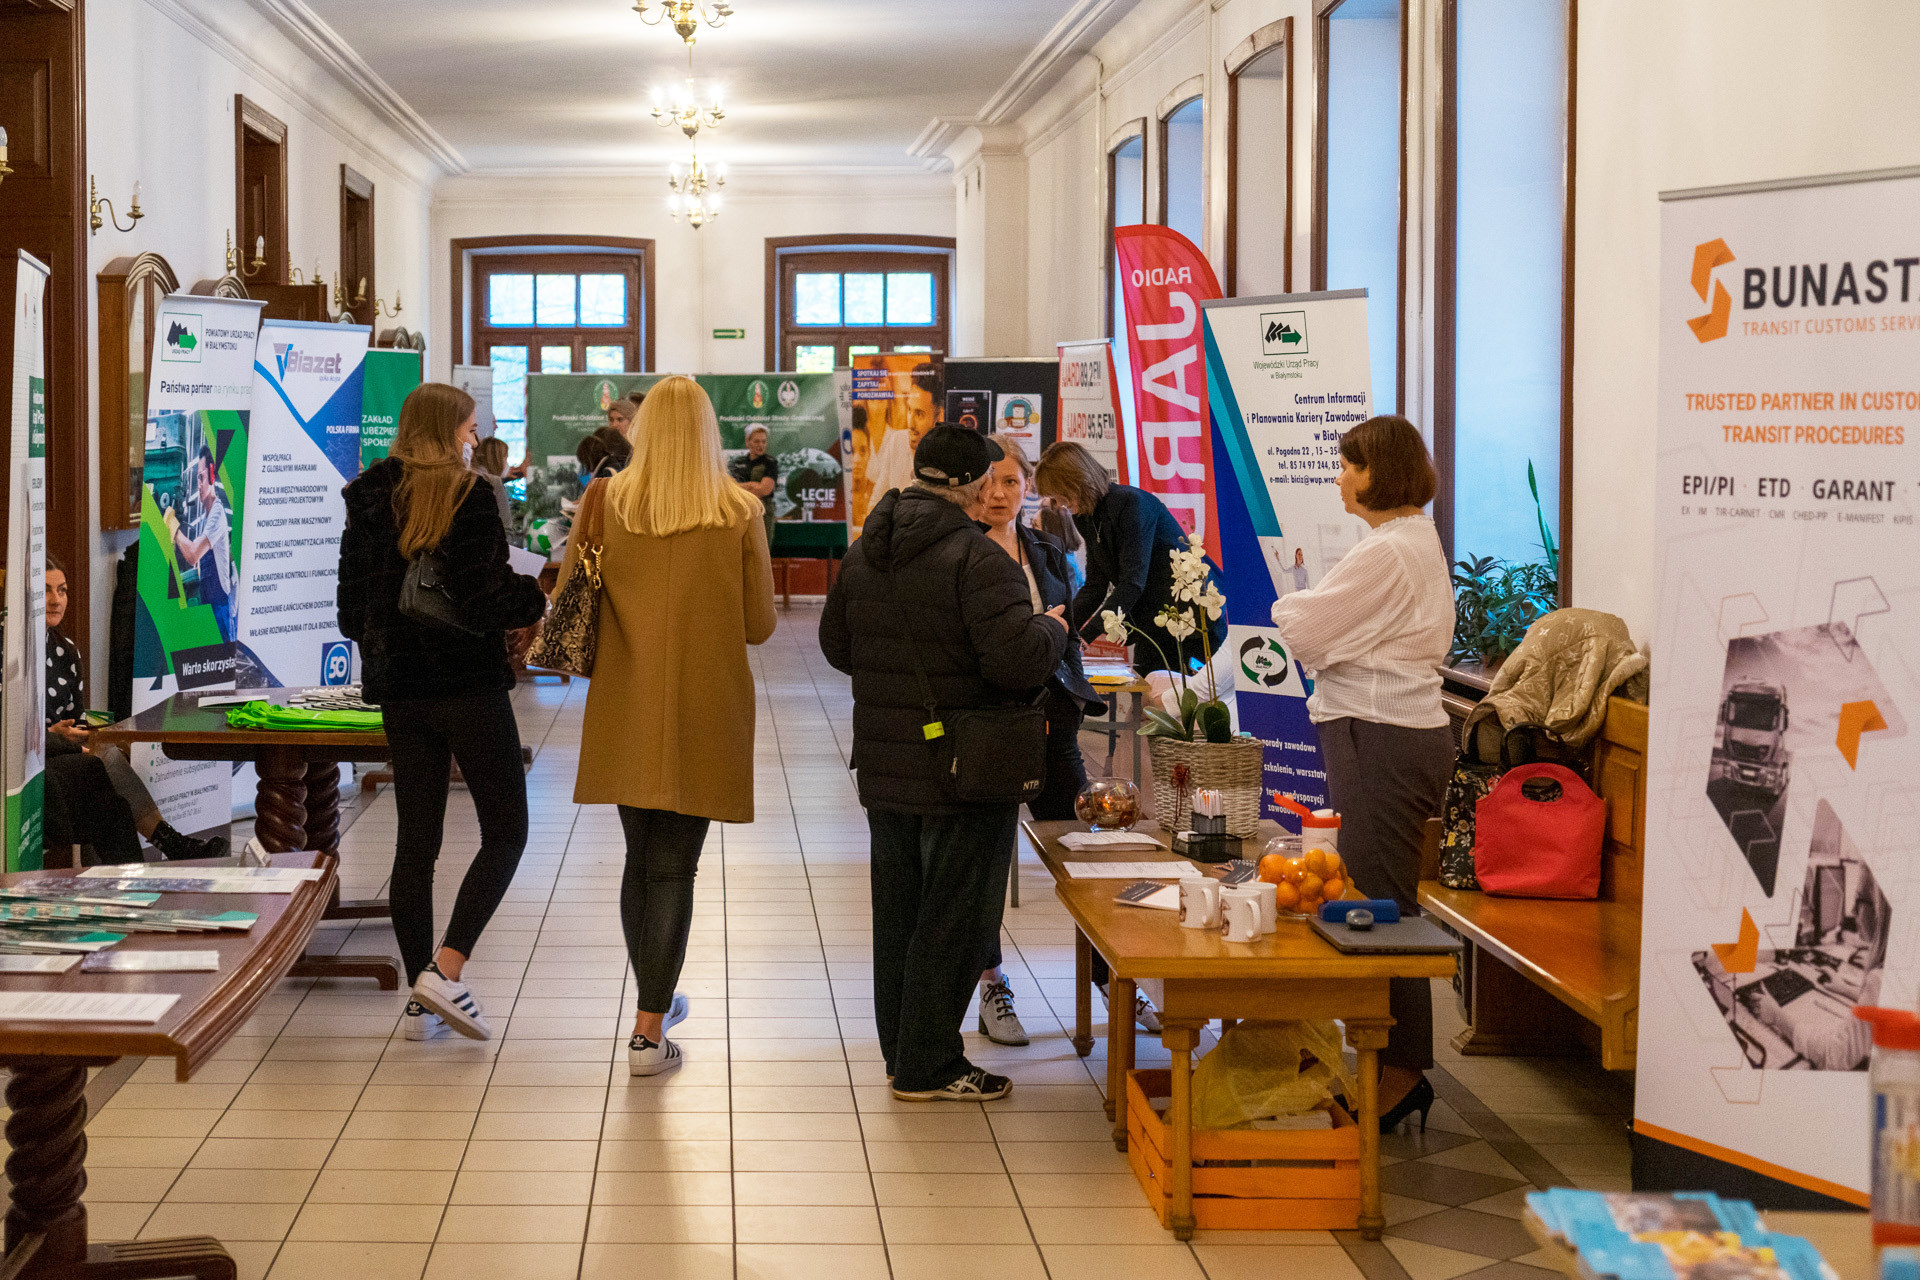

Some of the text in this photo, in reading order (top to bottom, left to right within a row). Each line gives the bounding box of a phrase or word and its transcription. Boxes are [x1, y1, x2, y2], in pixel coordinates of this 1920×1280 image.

[1743, 257, 1920, 310] BUNAST
[1743, 319, 1801, 337] TRANSIT
[1805, 316, 1876, 334] CUSTOMS
[243, 331, 255, 340] PRACY
[287, 350, 342, 374] Biazet
[1253, 358, 1319, 371] Wojewódzki Urząd Pracy
[1275, 371, 1303, 380] Białymstoku
[160, 380, 190, 394] Państwa
[191, 383, 213, 396] partner
[1294, 391, 1366, 406] Centrum Informacji
[1685, 391, 1920, 411] TRUSTED PARTNER IN CUSTO
[361, 415, 393, 424] ZAKŁAD
[1103, 413, 1115, 429] FM
[1251, 412, 1294, 424] Planowania
[1295, 411, 1323, 425] Kariery
[1325, 410, 1368, 423] Zawodowej
[326, 425, 360, 434] POLSKA FIRMA
[1322, 429, 1345, 441] Biały
[1722, 425, 1905, 445] TRANSIT PROCEDURES
[362, 437, 394, 446] SPOŁEC
[262, 452, 292, 461] WSPÓŁPRACA
[1267, 447, 1275, 456] ul.
[1275, 447, 1301, 457] Pogodna
[1301, 447, 1310, 455] 22
[1315, 447, 1323, 455] 15
[267, 464, 293, 473] GLOBALNYMI
[294, 463, 317, 472] MARKAMI
[1278, 461, 1340, 470] tel. 85 74 97 244, 85
[1269, 475, 1289, 484] e-mail:
[258, 486, 275, 495] PRACA
[1682, 475, 1896, 501] EPI/PI ETD GARANT
[288, 496, 324, 504] PROJEKTOWYM
[256, 516, 332, 528] NOWOCZESNY PARK MASZYNOWY
[255, 541, 281, 549] TWORZENIE
[284, 538, 324, 547] AUTOMATYZACJA
[254, 550, 293, 560] PRODUKCYJNYCH
[253, 573, 284, 582] LABORATORIA
[285, 571, 309, 579] KONTROLI
[252, 584, 277, 593] PRODUKTU
[250, 600, 334, 616] ZARZĄDZANIE ŁAŃCUCHEM DOSTAW
[249, 627, 269, 637] WŁASNE
[269, 624, 302, 635] ROZWIĄZANIA
[308, 622, 318, 631] DLA
[182, 660, 201, 677] Warto
[328, 655, 348, 679] 50
[1284, 741, 1316, 753] zawodowe
[1263, 761, 1327, 782] szkolenia, warsztaty
[1282, 790, 1325, 806] prdyspozycji
